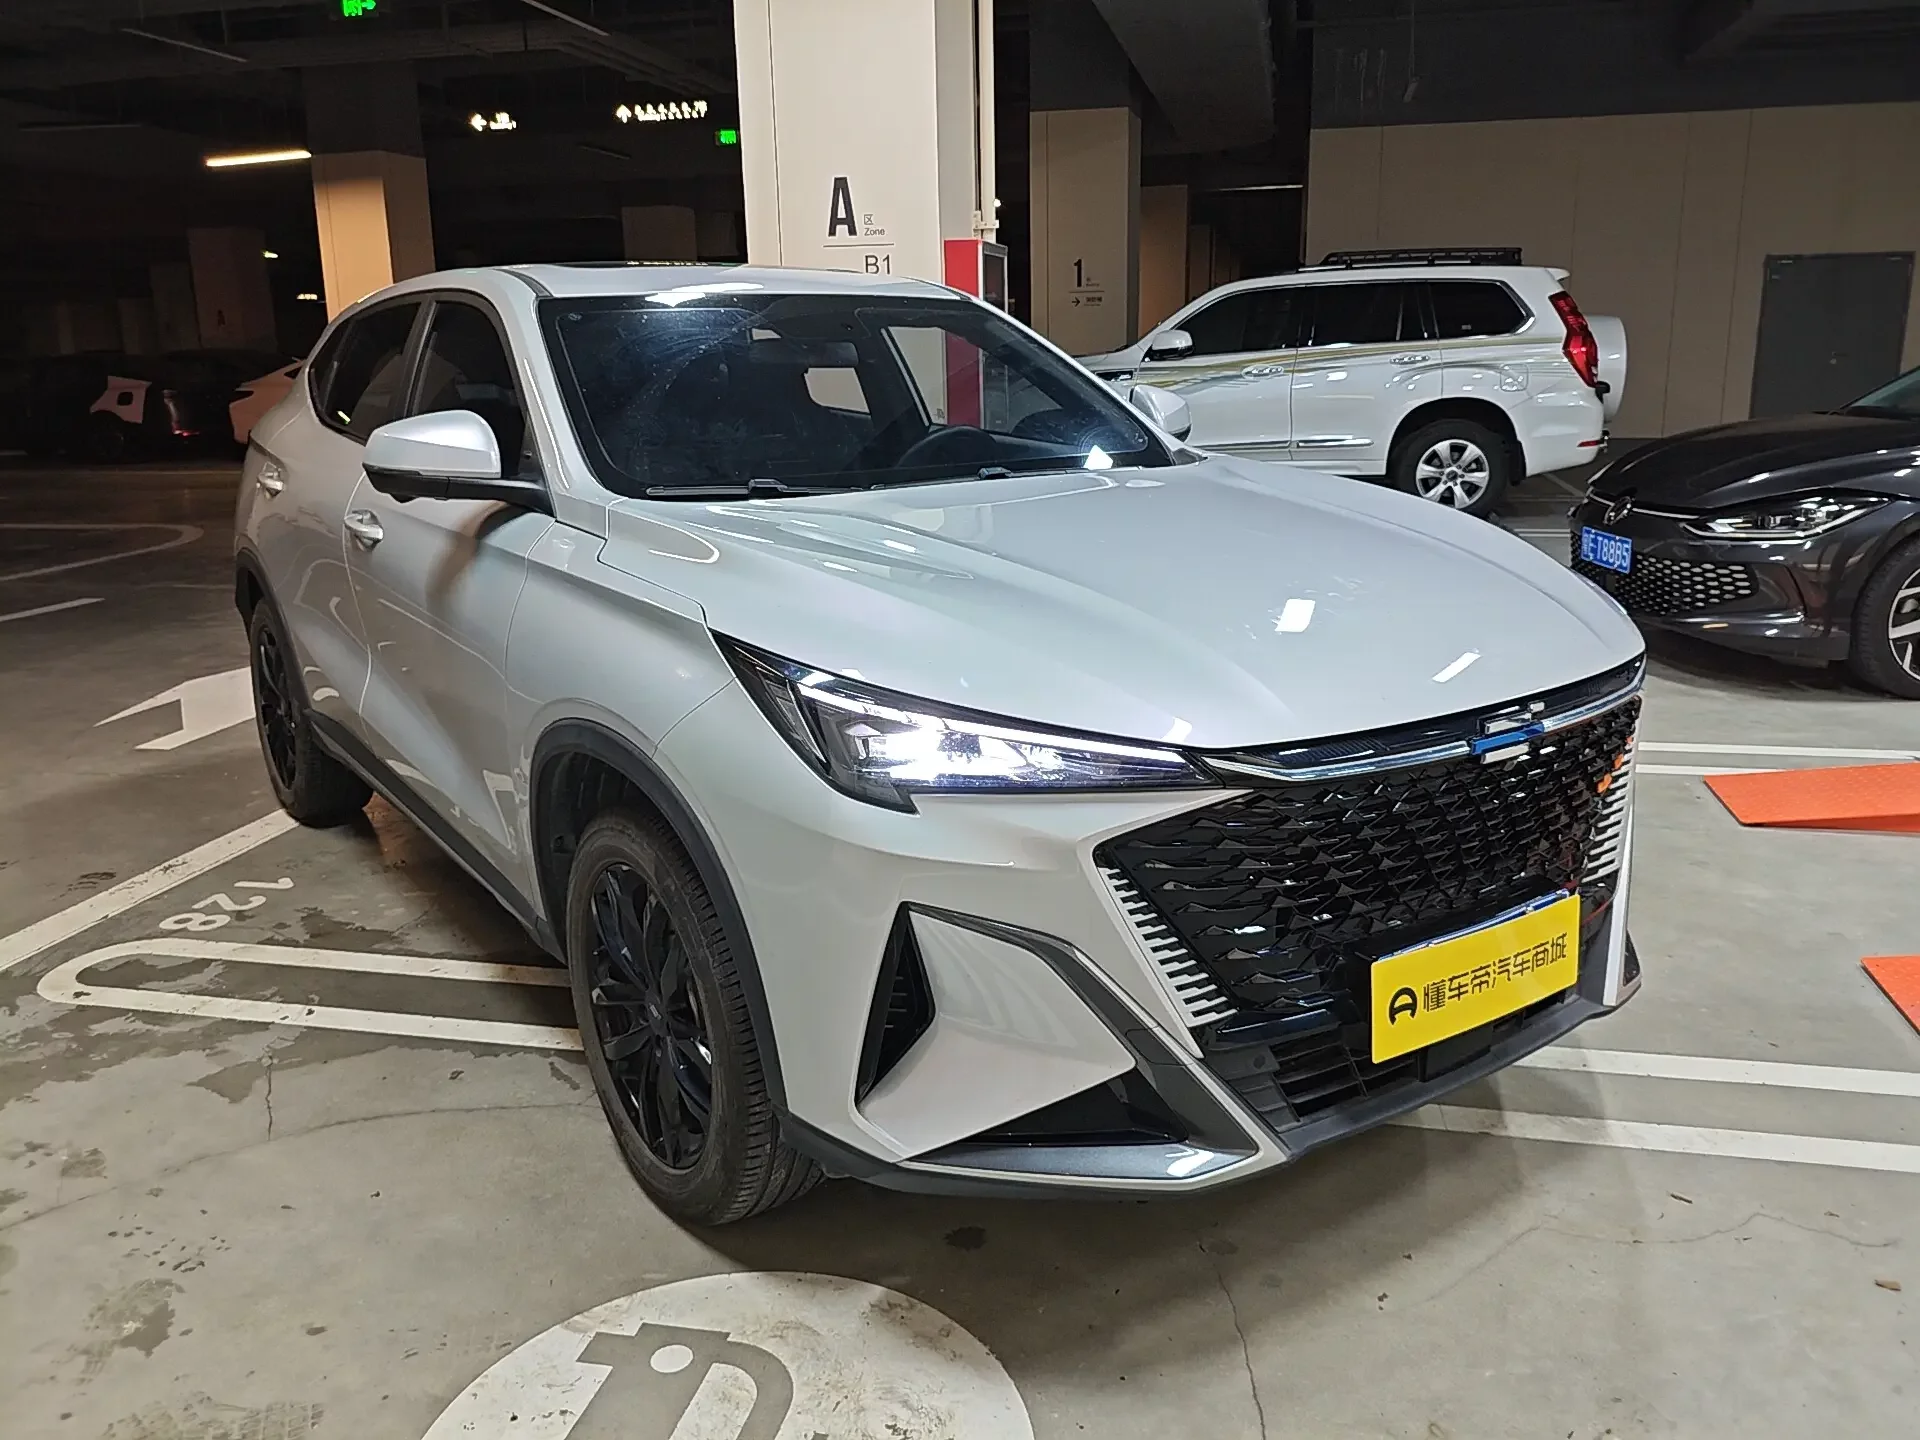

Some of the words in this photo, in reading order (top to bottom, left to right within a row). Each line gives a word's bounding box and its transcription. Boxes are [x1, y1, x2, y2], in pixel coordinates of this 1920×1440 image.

[827, 177, 858, 237] A
[863, 214, 874, 225] 区
[864, 227, 886, 236] Zone
[864, 253, 891, 275] B1
[1073, 258, 1082, 288] 1
[159, 877, 295, 931] 128
